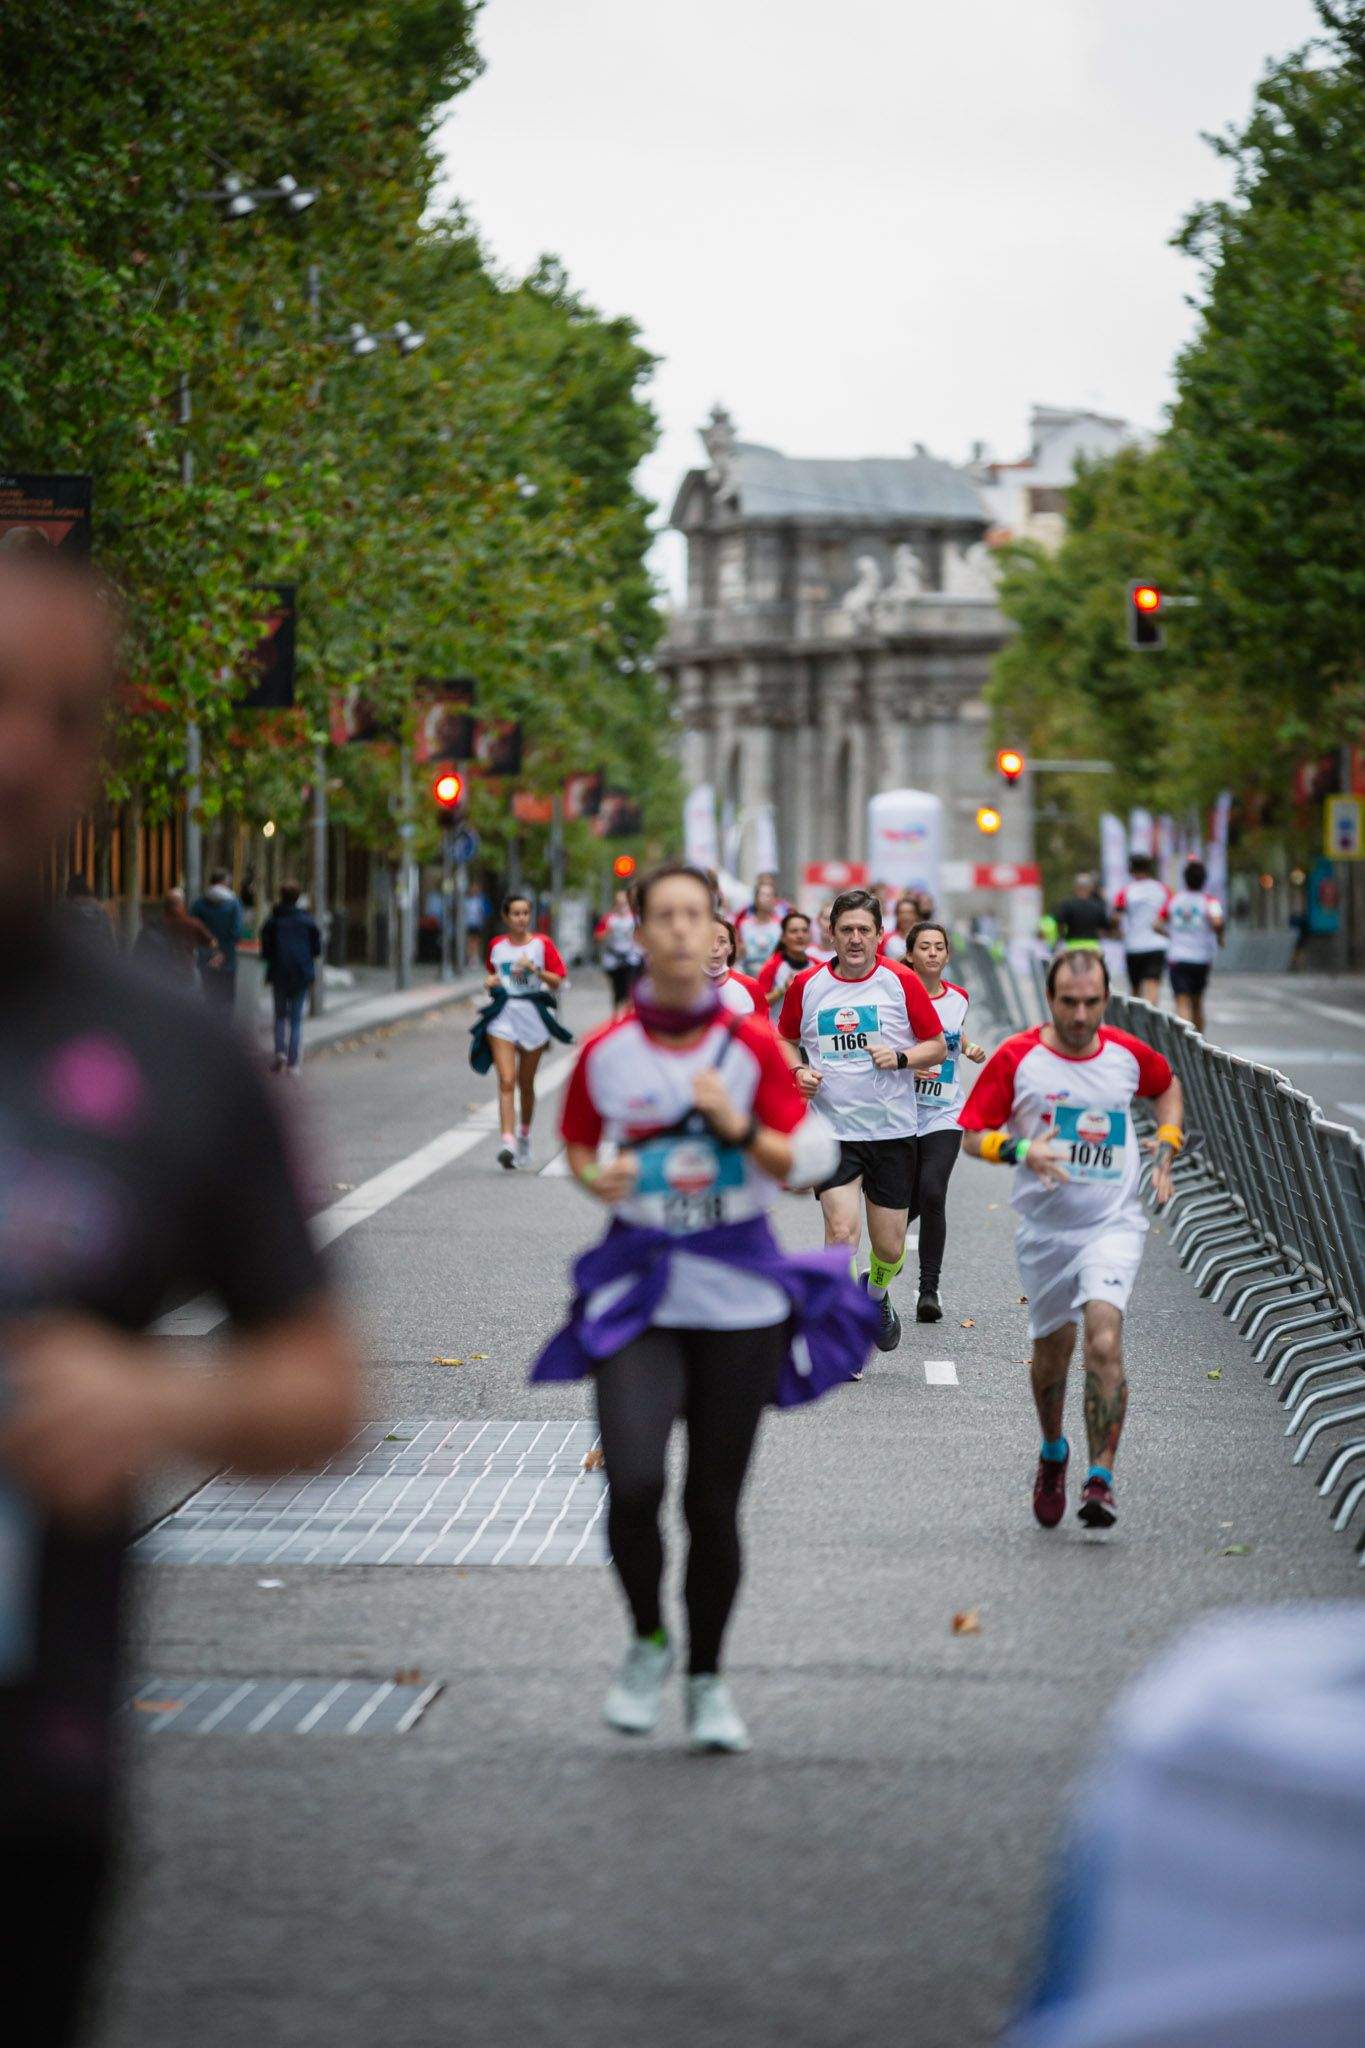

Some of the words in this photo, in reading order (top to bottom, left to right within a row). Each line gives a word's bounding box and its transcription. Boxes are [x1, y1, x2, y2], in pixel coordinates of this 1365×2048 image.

[831, 1033, 867, 1051] 1166
[914, 1079, 942, 1096] 1170
[1069, 1142, 1112, 1168] 1076
